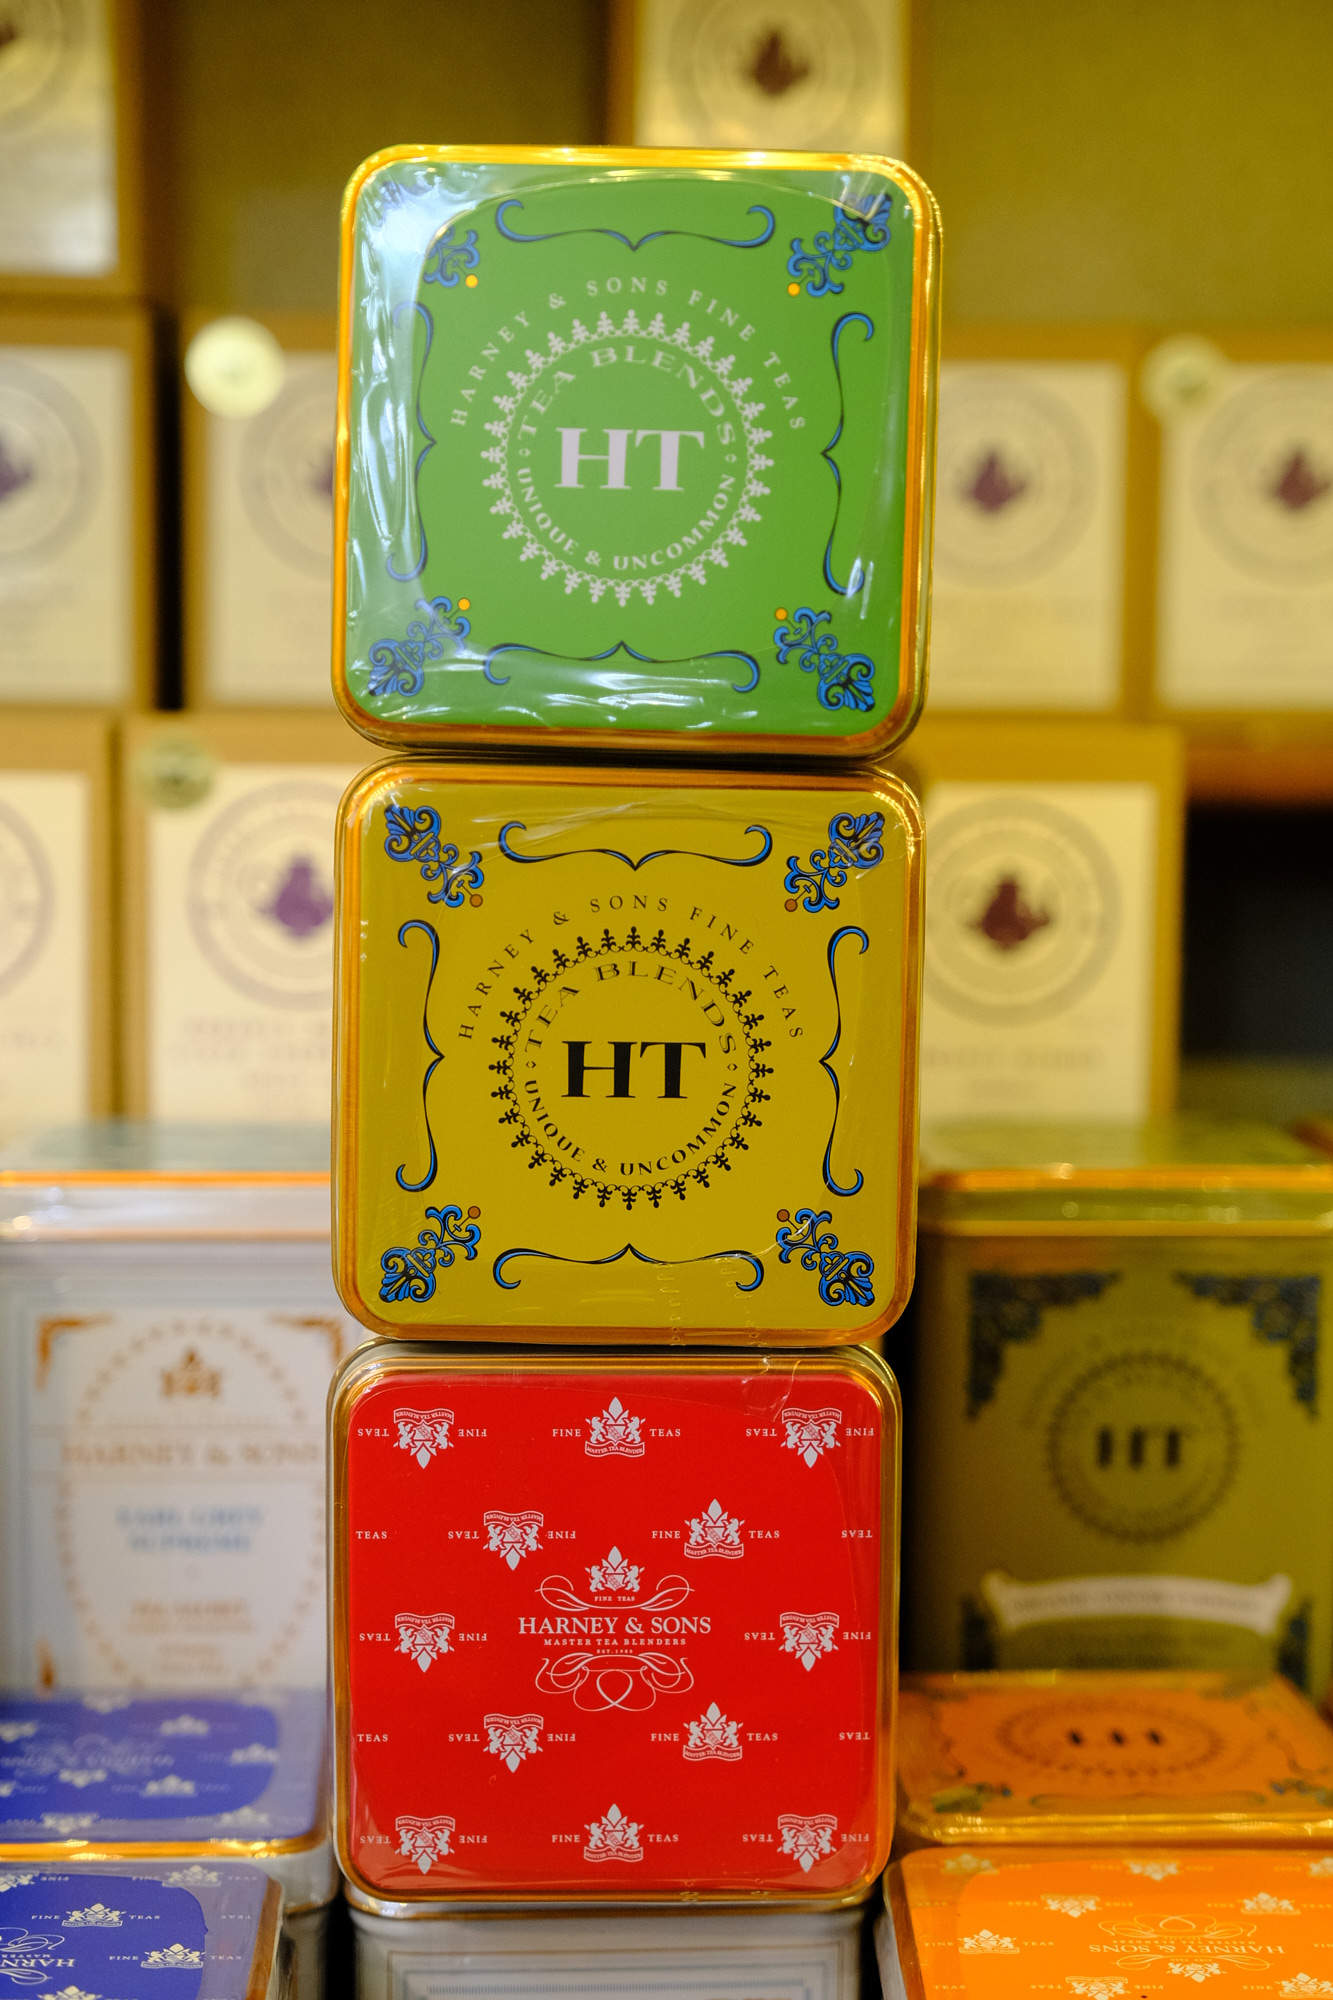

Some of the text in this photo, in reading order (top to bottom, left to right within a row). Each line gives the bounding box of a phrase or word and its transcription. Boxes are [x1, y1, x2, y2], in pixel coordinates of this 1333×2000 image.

[450, 276, 806, 430] HARNEY & SONS FINE TEAS
[517, 344, 736, 446] TEA BLENDS
[553, 427, 705, 491] HT
[516, 467, 737, 571] UNIQUE & UNCOMMON
[458, 894, 804, 1040] HARNEY & SONS FINE TEAS
[524, 960, 738, 1055] TEA BLENDS
[560, 1040, 707, 1100] HT
[524, 1078, 738, 1176] UNIQUE & UNCOMMON
[846, 1428, 874, 1436] FINE
[356, 1531, 387, 1539] TEAS
[448, 1531, 479, 1539] TEAS
[842, 1530, 872, 1538] TEAS
[519, 1617, 710, 1634] HARNEY & SONS
[360, 1633, 487, 1641] FINE TEAS
[745, 1632, 775, 1640] TEAS
[357, 1734, 388, 1742] TEAS
[651, 1733, 777, 1741] FINE TEAS
[839, 1732, 870, 1740] TEAS
[648, 1834, 678, 1842] TEAS
[743, 1834, 870, 1842] FINE TEAS
[1088, 1944, 1286, 1954] HARNEY & SONS
